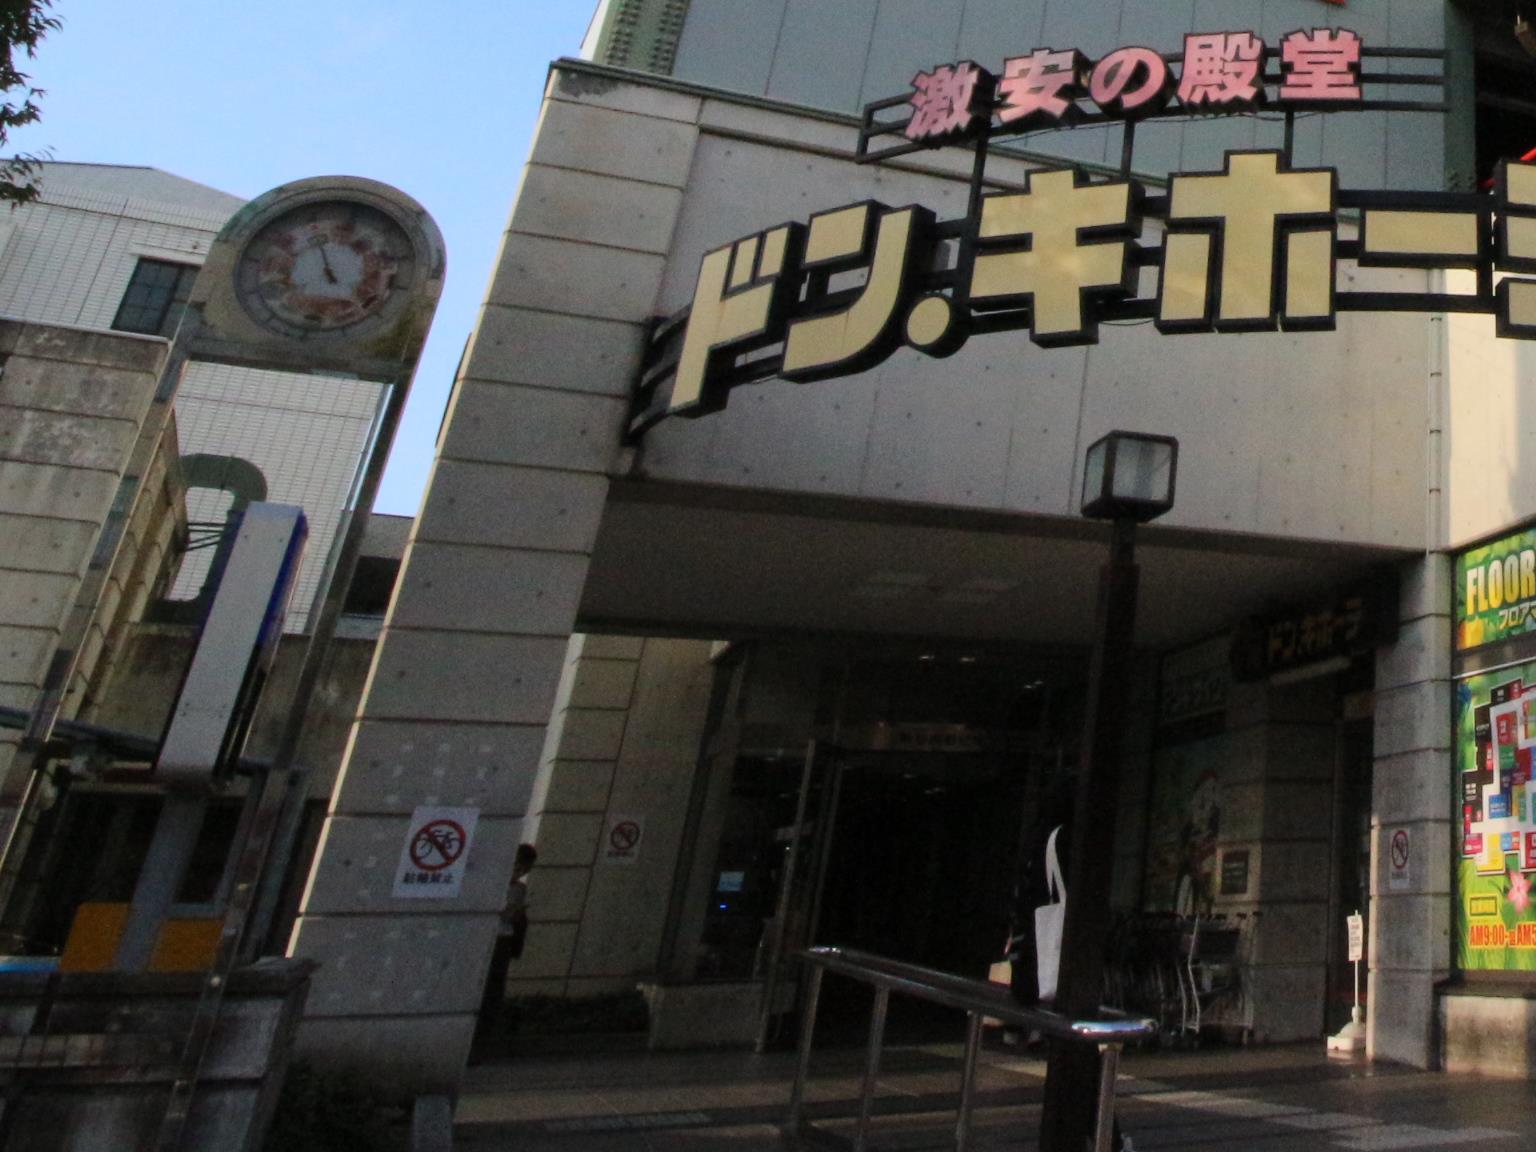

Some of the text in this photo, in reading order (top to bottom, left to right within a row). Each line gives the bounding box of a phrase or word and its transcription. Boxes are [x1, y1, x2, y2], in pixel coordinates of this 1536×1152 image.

[904, 28, 1363, 141] 激安の殿堂
[1466, 548, 1536, 616] FLOOR
